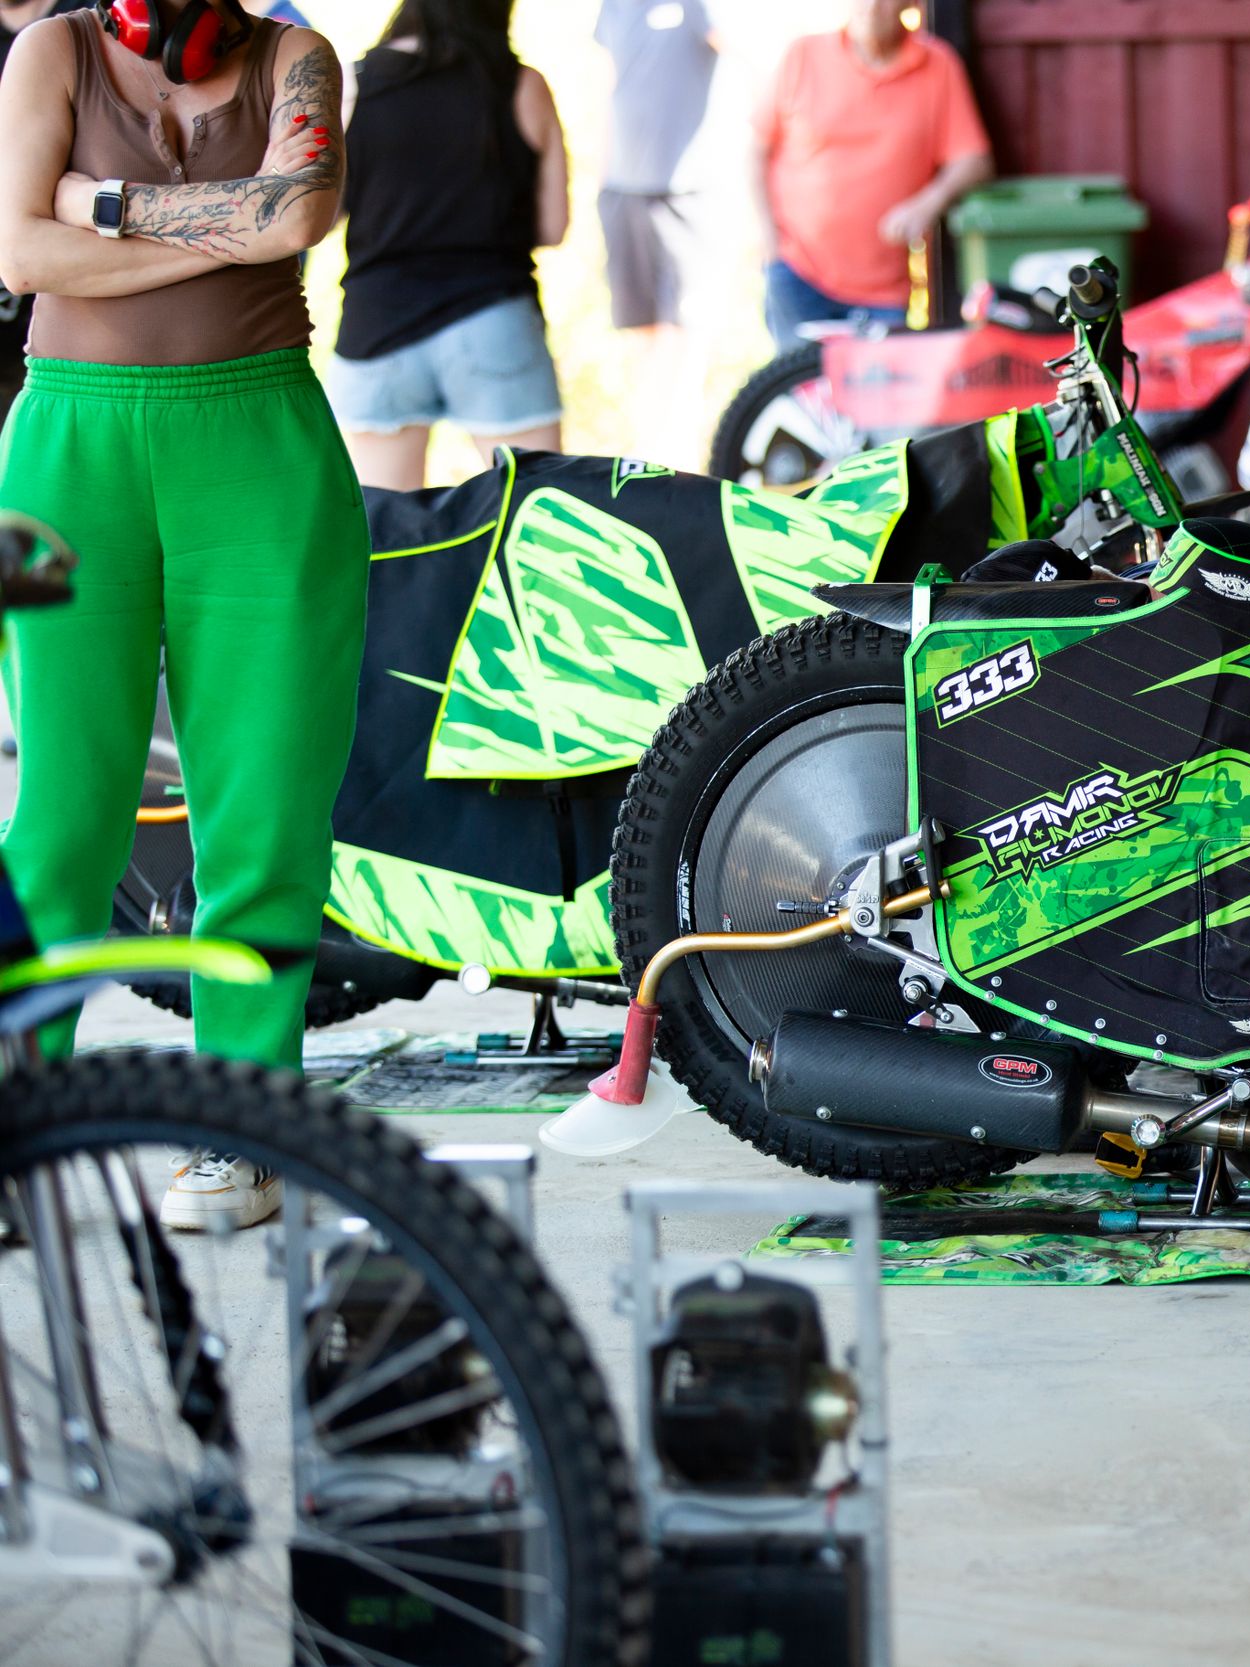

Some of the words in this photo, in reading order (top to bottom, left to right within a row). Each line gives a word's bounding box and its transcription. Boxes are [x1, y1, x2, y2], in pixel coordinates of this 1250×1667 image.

[938, 644, 1035, 720] 333
[978, 775, 1124, 848] DAMIR
[996, 773, 1174, 867] FILIMONOV
[1041, 813, 1139, 862] RACING
[993, 1058, 1038, 1075] GPM
